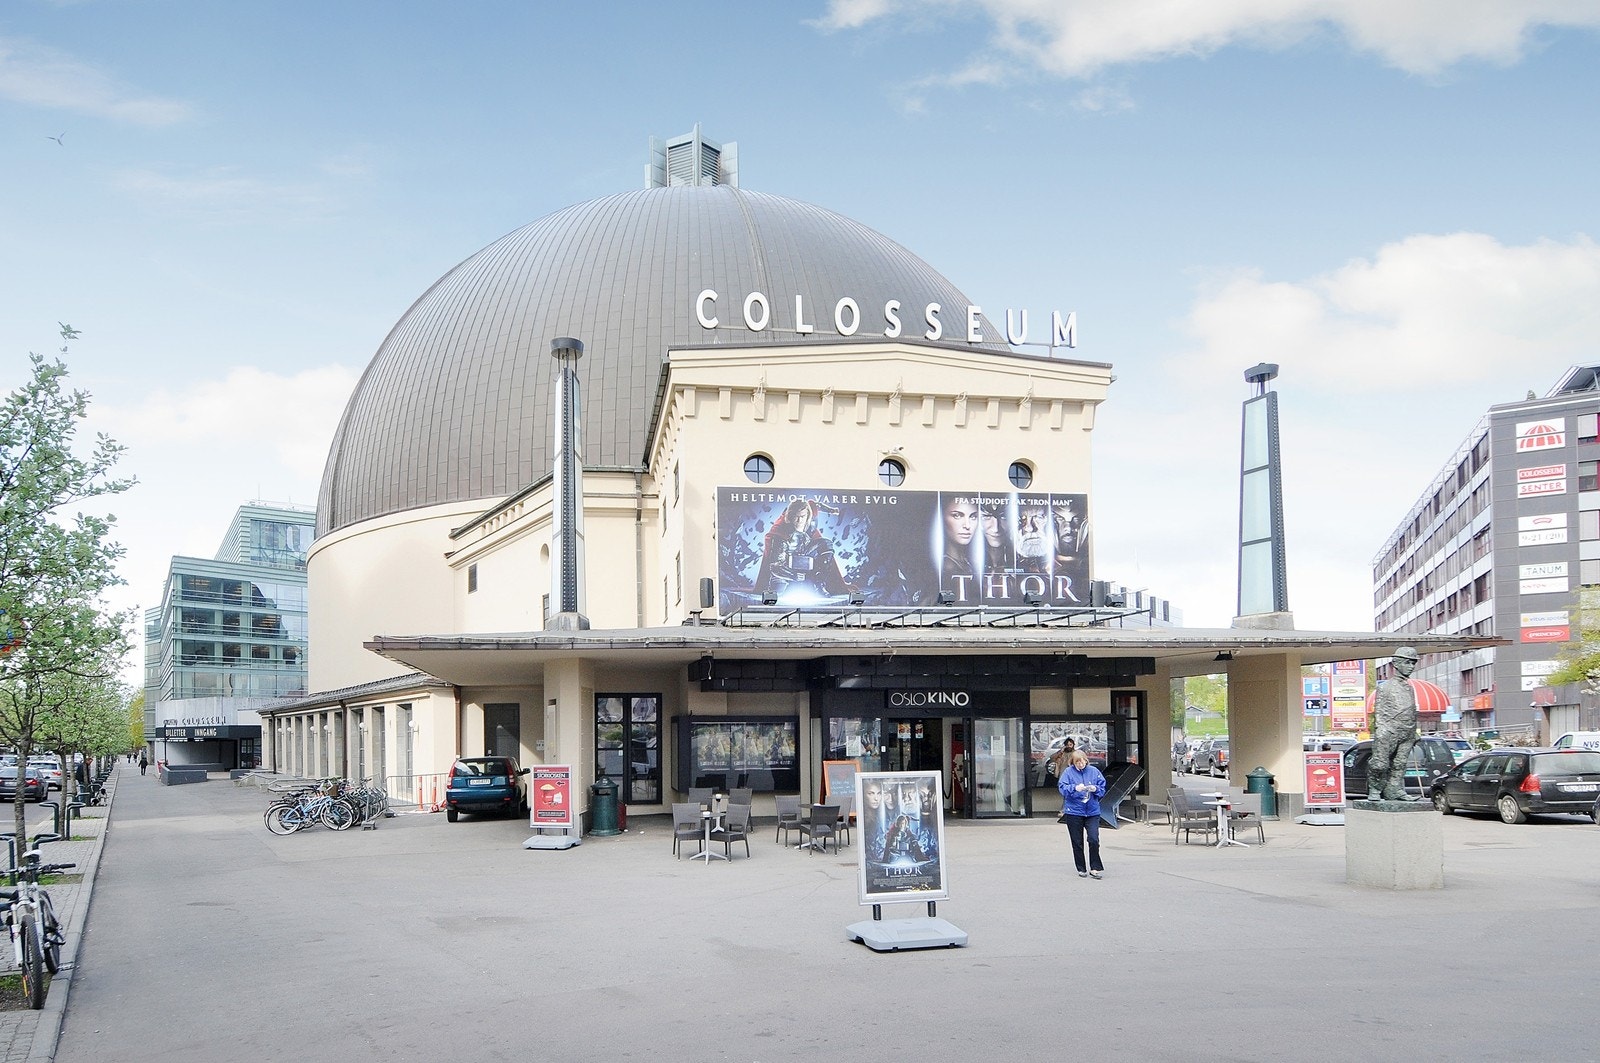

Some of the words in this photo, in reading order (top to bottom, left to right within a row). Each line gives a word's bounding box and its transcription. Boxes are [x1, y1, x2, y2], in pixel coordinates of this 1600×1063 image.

[695, 288, 1078, 349] COLOSSEUM
[1520, 466, 1563, 478] COLOSSEUM
[1521, 481, 1562, 493] SENTER
[730, 493, 807, 503] HELTEMOT
[814, 494, 858, 504] VARER
[865, 495, 898, 505] EVIG
[954, 497, 969, 505] FRA
[970, 497, 1010, 506] STUDIOET
[1012, 498, 1026, 506] AK
[1526, 565, 1562, 576] TANUM
[951, 574, 1082, 603] THOR
[165, 728, 186, 736] BILLETTER
[194, 727, 217, 737] INNGANG
[1583, 740, 1600, 748] NVS
[884, 867, 922, 877] THOR
